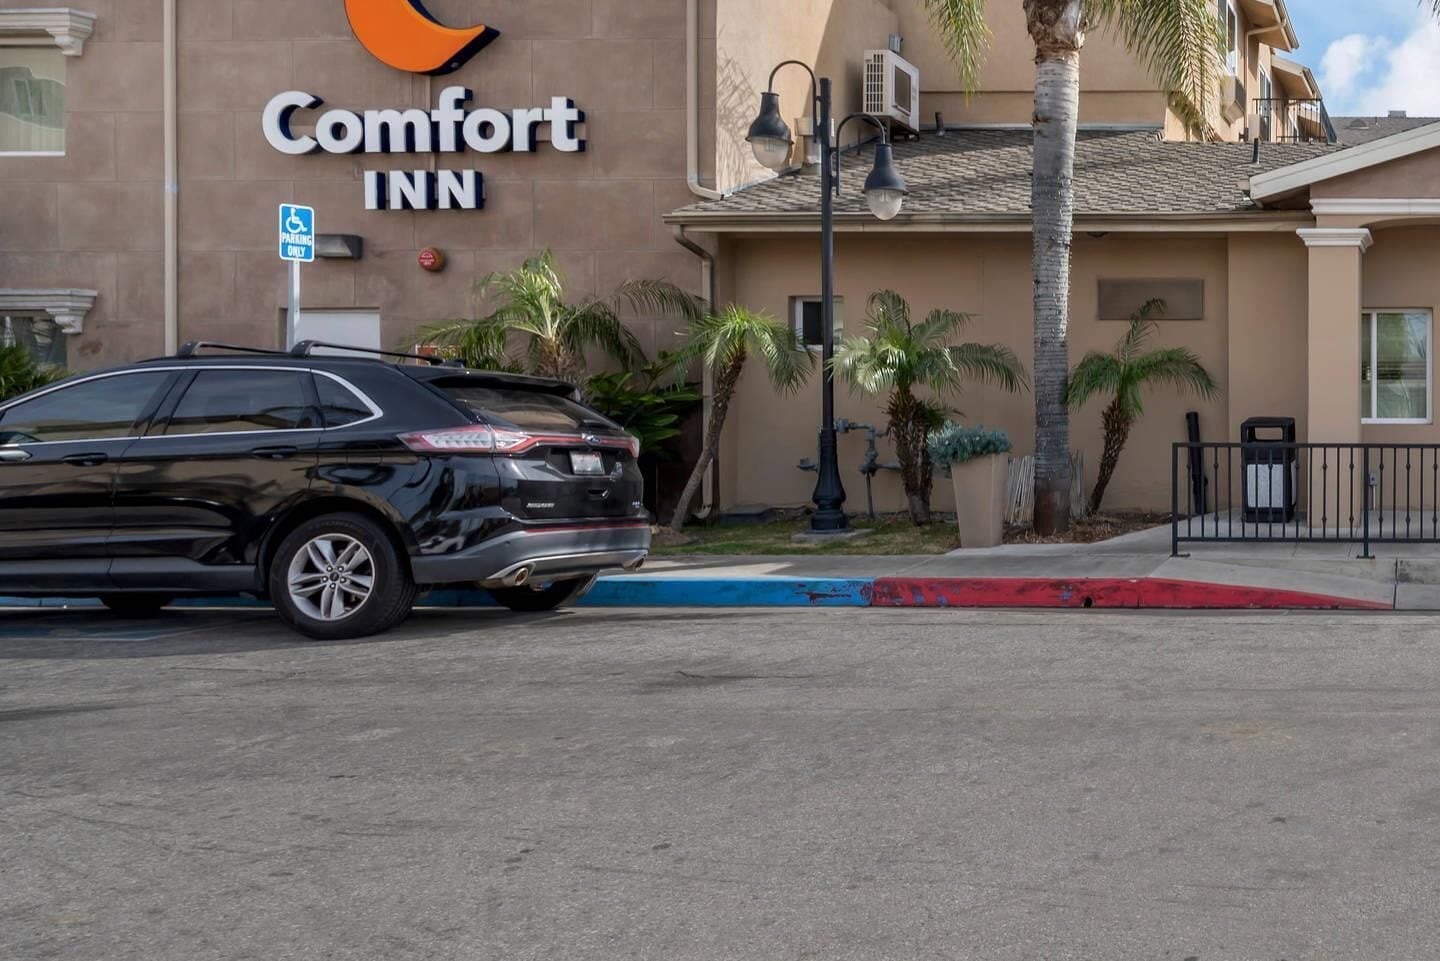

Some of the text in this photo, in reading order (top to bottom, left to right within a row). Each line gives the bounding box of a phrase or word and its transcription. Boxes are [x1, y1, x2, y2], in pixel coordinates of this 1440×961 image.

[262, 86, 586, 155] Comfort
[364, 169, 484, 211] INN
[281, 231, 312, 246] PARKING
[287, 244, 306, 258] ONLY
